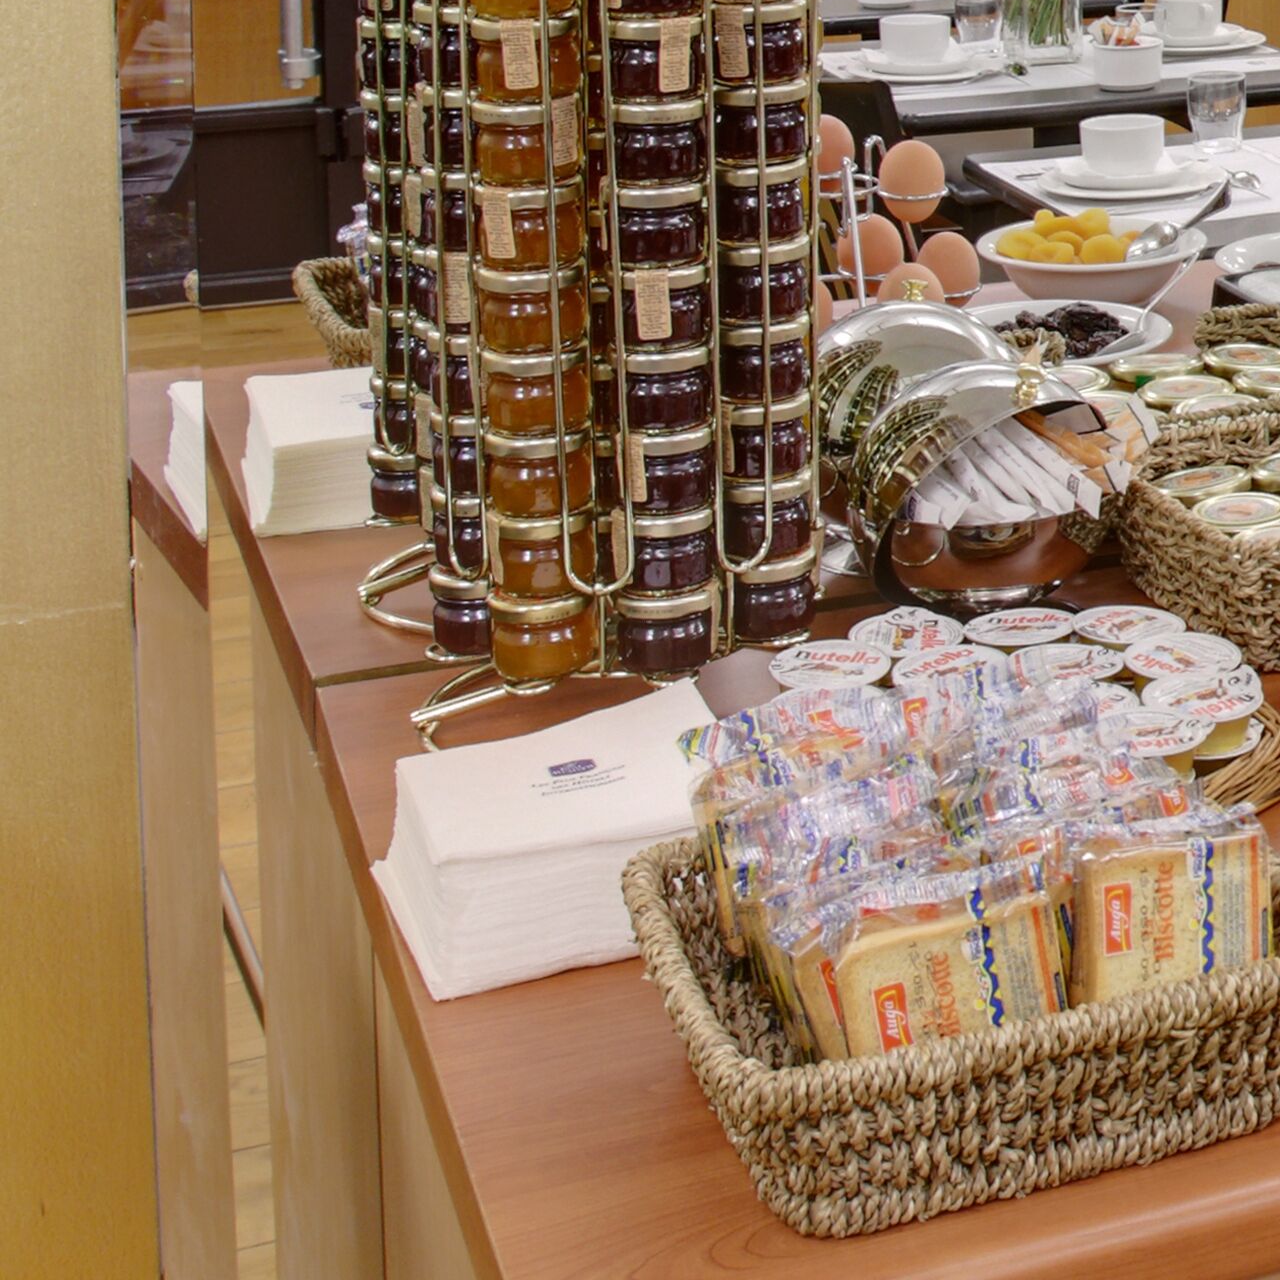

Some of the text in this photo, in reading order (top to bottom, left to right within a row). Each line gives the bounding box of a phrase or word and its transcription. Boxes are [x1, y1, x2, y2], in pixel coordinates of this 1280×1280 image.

[988, 614, 1071, 625] nutella
[795, 648, 881, 666] nutella
[900, 648, 974, 679] nutella
[1110, 899, 1129, 942] Auga
[1153, 860, 1175, 961] Biscotte
[885, 1000, 906, 1039] Auga
